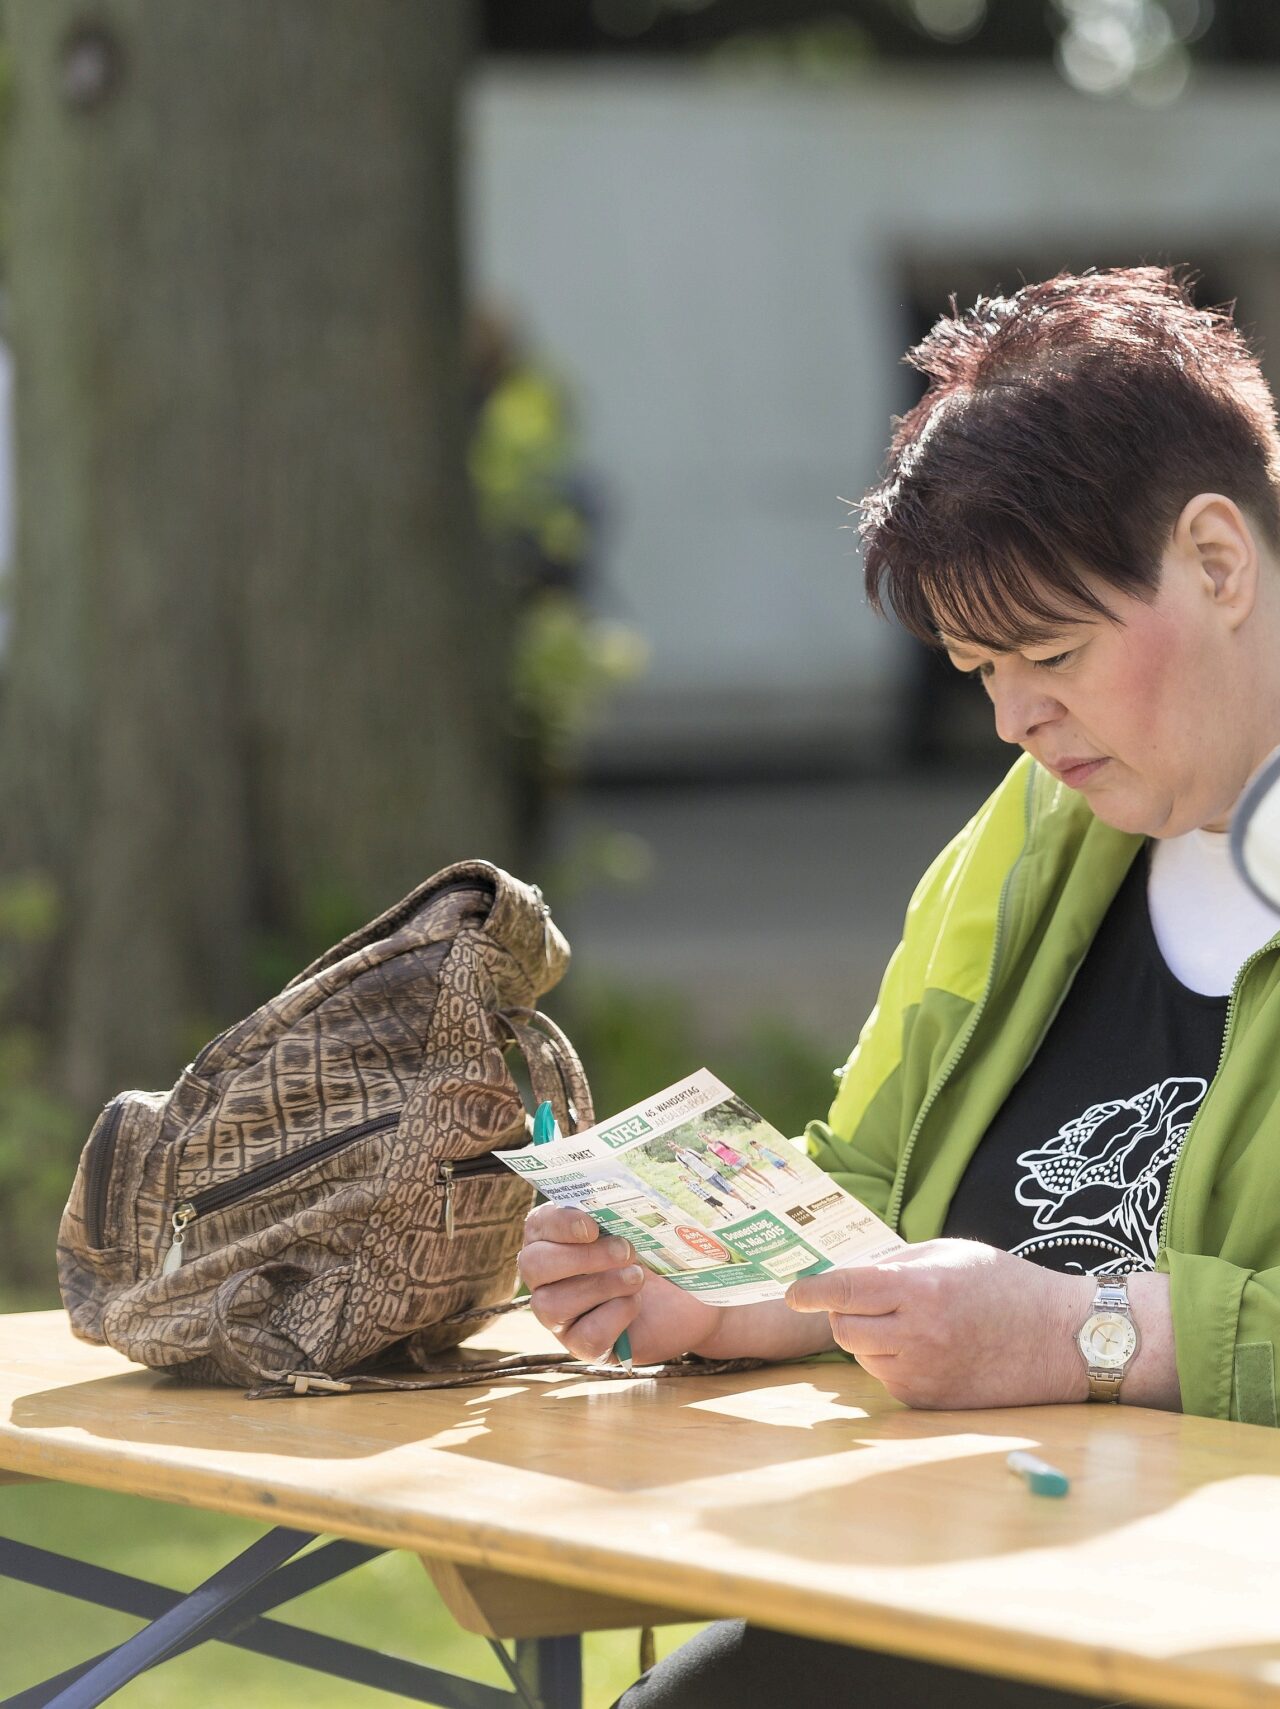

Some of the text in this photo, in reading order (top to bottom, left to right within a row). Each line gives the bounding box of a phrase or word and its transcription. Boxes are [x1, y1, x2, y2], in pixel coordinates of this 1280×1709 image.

[656, 1086, 700, 1113] WANDERTAG
[722, 1219, 773, 1240] Donnerstag,
[734, 1226, 785, 1251] 14. Mai 2015
